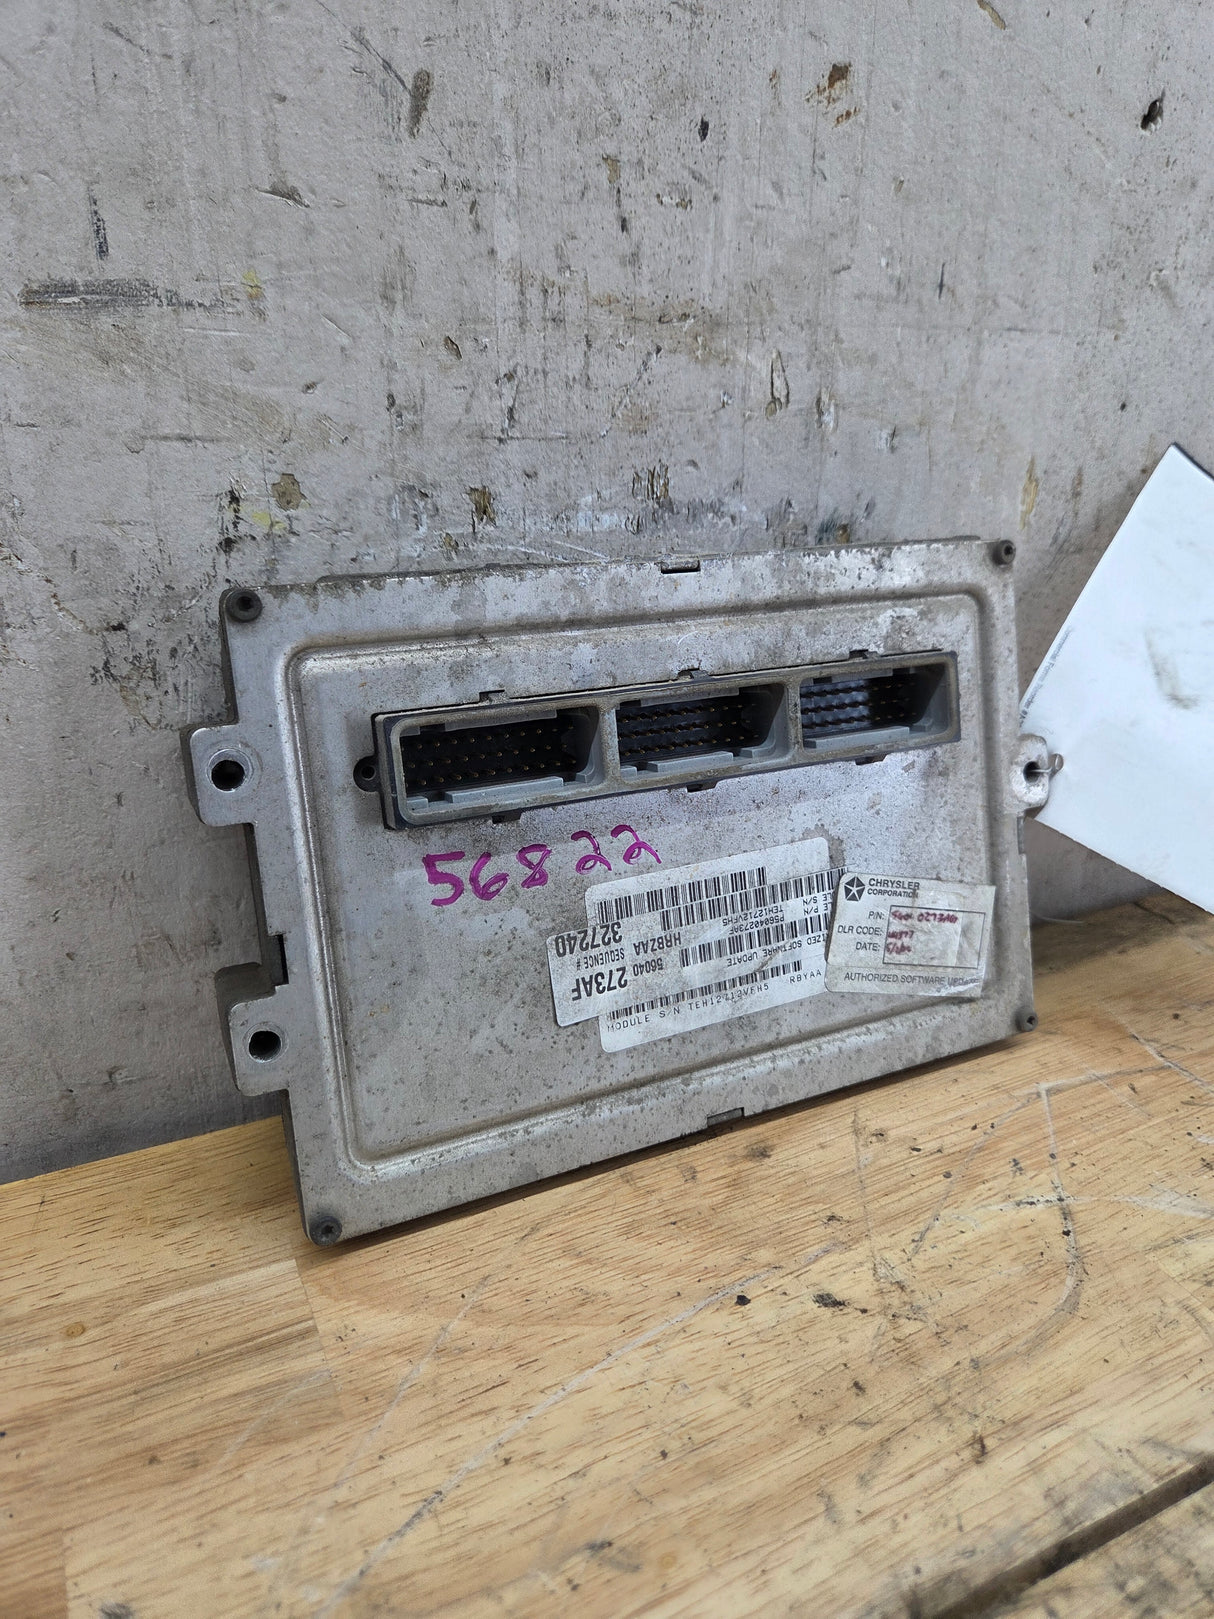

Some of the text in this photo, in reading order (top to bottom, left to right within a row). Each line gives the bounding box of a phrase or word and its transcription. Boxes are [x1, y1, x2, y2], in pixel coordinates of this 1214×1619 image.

[867, 877, 921, 890] CHRYSLER
[866, 888, 919, 899] CORPORATION
[802, 895, 818, 906] S/N
[803, 905, 819, 916] P/N
[868, 910, 885, 920] P/N:
[837, 924, 854, 934] DLR
[855, 925, 882, 936] CODE:
[554, 921, 623, 958] 327240
[632, 931, 682, 956] HRBZAA
[855, 941, 881, 952] DATE:
[583, 947, 625, 969] SEQUENCE
[726, 951, 758, 967] UPDATE
[571, 957, 664, 1001] 56040 273AF
[843, 971, 898, 983] AUTHORIZED
[901, 974, 946, 985] SOFTWARE
[606, 1015, 651, 1032] MODULE
[658, 1006, 681, 1018] S/N
